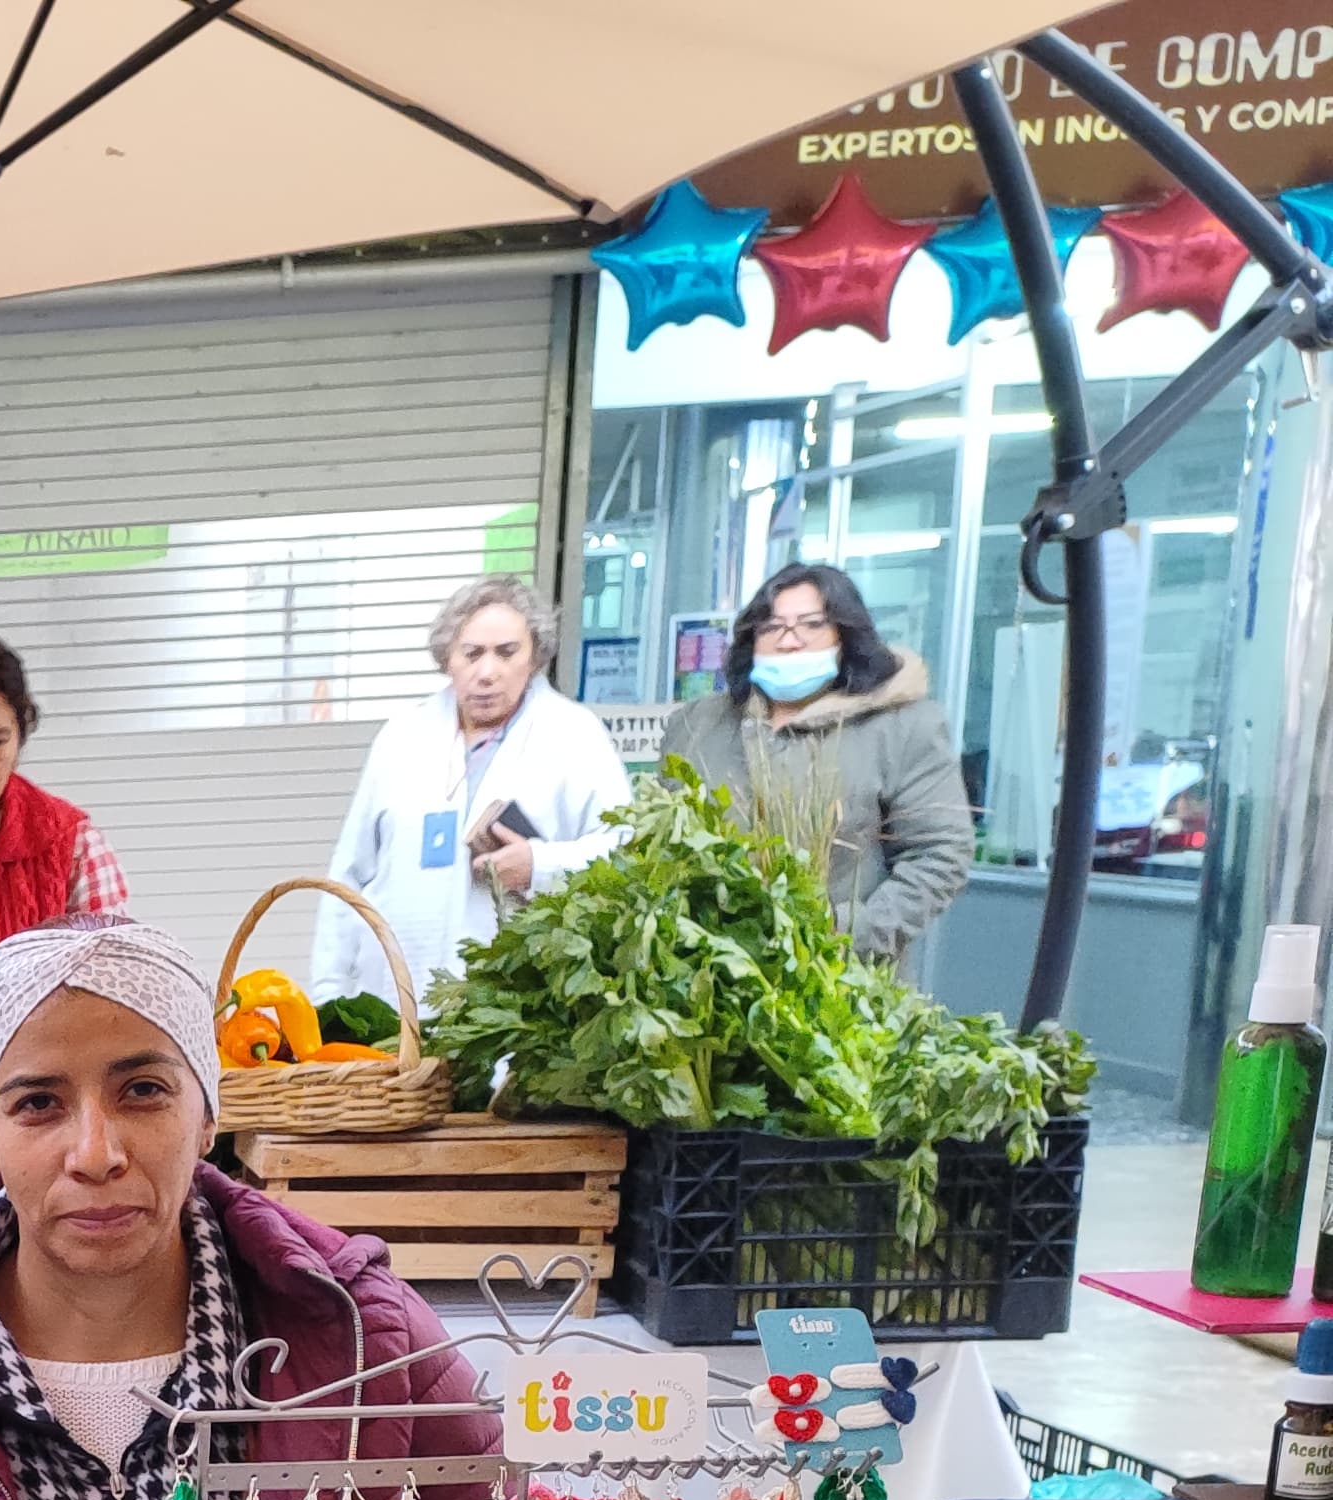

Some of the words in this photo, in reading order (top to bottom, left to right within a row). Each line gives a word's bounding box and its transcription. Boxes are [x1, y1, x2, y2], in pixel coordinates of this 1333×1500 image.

[1196, 103, 1222, 133] Y
[789, 1314, 833, 1334] tissu
[517, 1371, 669, 1433] tissu
